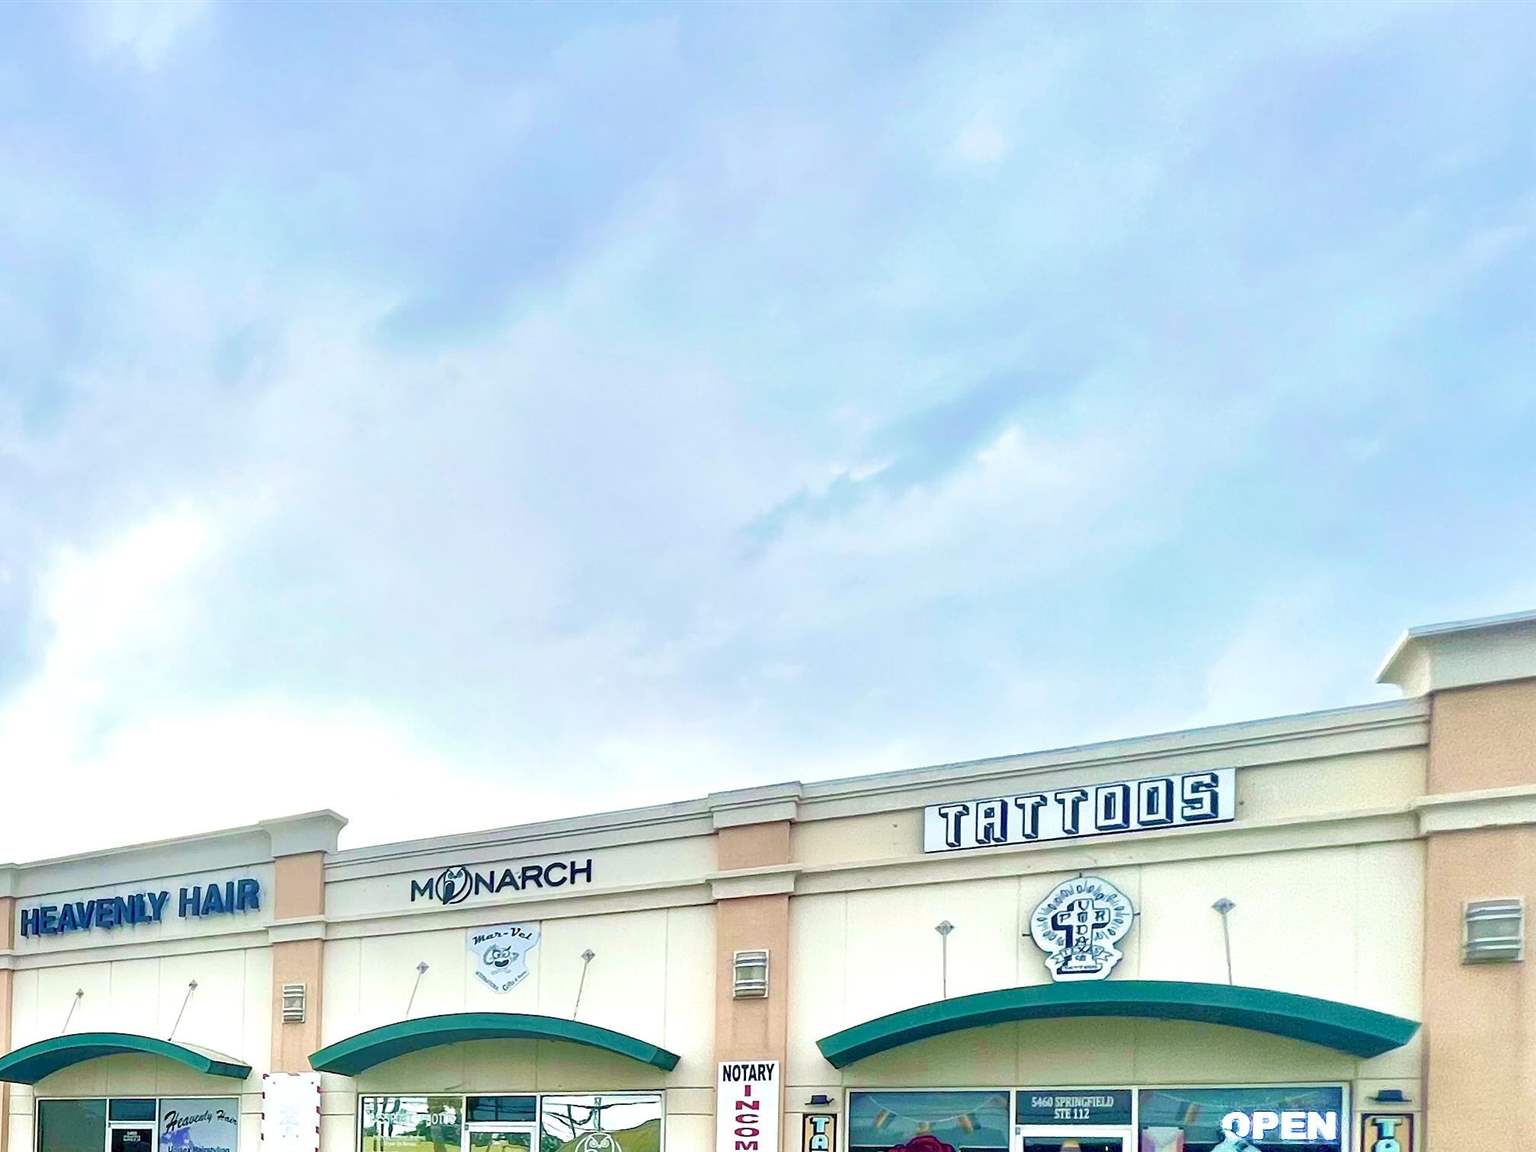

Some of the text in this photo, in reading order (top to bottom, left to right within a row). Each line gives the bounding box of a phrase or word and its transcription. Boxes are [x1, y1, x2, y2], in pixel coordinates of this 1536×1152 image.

[938, 772, 1218, 847] TATTOOS
[411, 859, 592, 905] MONARCH
[20, 878, 260, 938] HEAVENLY HAIR
[723, 1064, 774, 1081] NOTARY
[1032, 1096, 1114, 1108] 5460 SPRINGFIELD
[1054, 1108, 1090, 1119] STE 112
[163, 1109, 238, 1136] Heavenly Hair
[1221, 1111, 1337, 1140] OPEN
